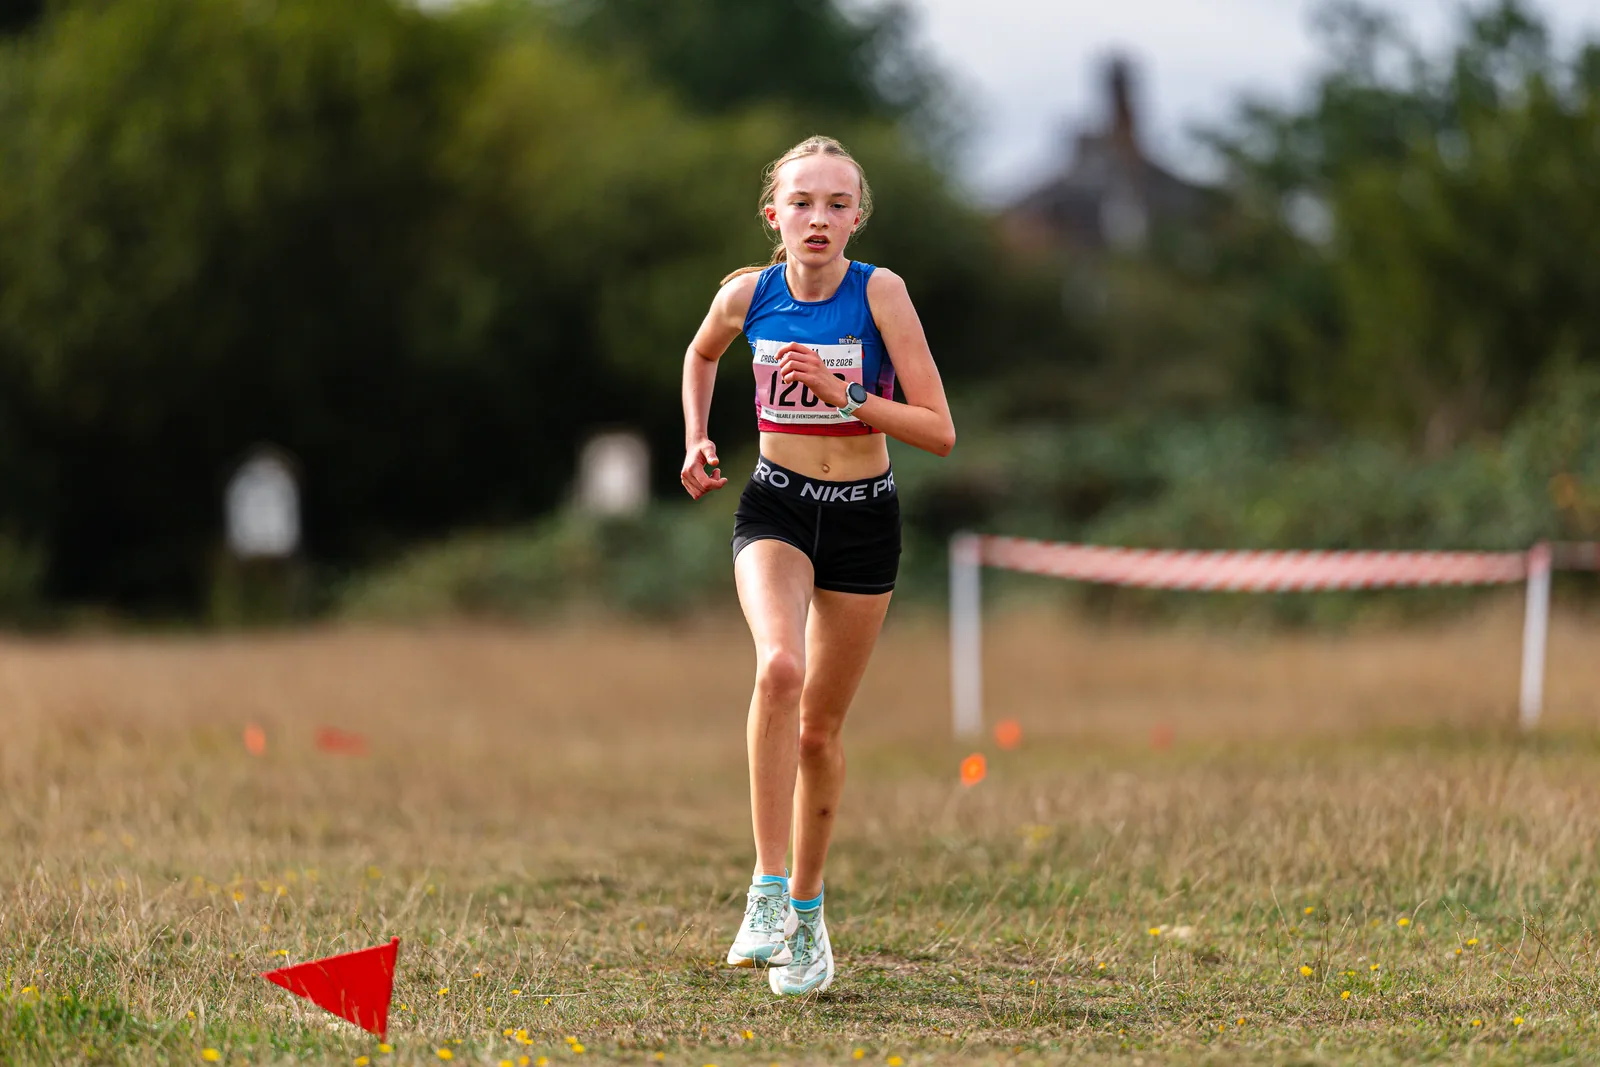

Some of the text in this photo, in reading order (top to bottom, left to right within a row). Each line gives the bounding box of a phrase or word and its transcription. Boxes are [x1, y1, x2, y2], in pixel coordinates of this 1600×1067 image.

[836, 358, 853, 366] 2026
[769, 370, 845, 408] 120
[800, 482, 868, 502] NIKE
